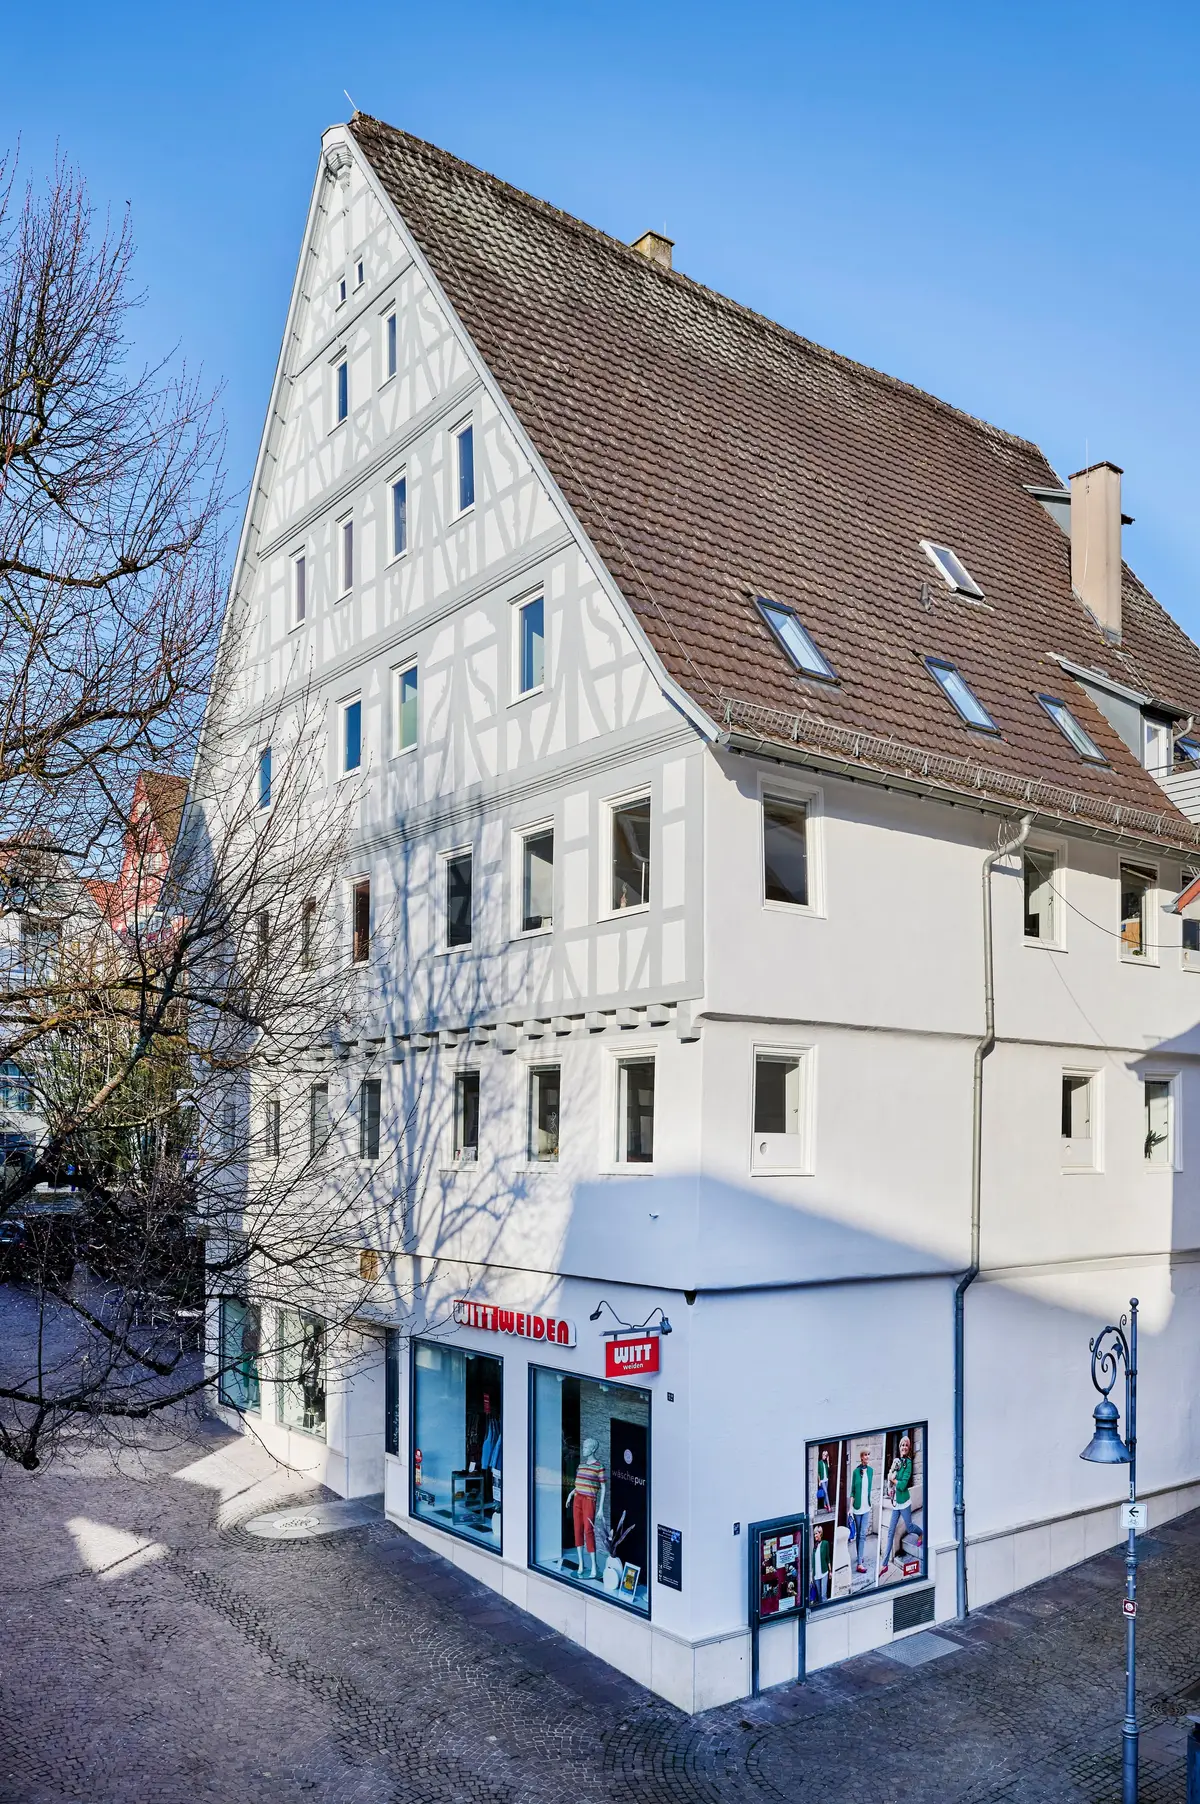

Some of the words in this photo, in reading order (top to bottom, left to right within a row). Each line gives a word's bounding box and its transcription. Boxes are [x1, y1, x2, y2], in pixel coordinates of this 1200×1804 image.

[453, 1300, 494, 1330] WITT
[498, 1309, 569, 1345] WEIDEN
[614, 1344, 652, 1364] WITT
[623, 1362, 644, 1370] weiden
